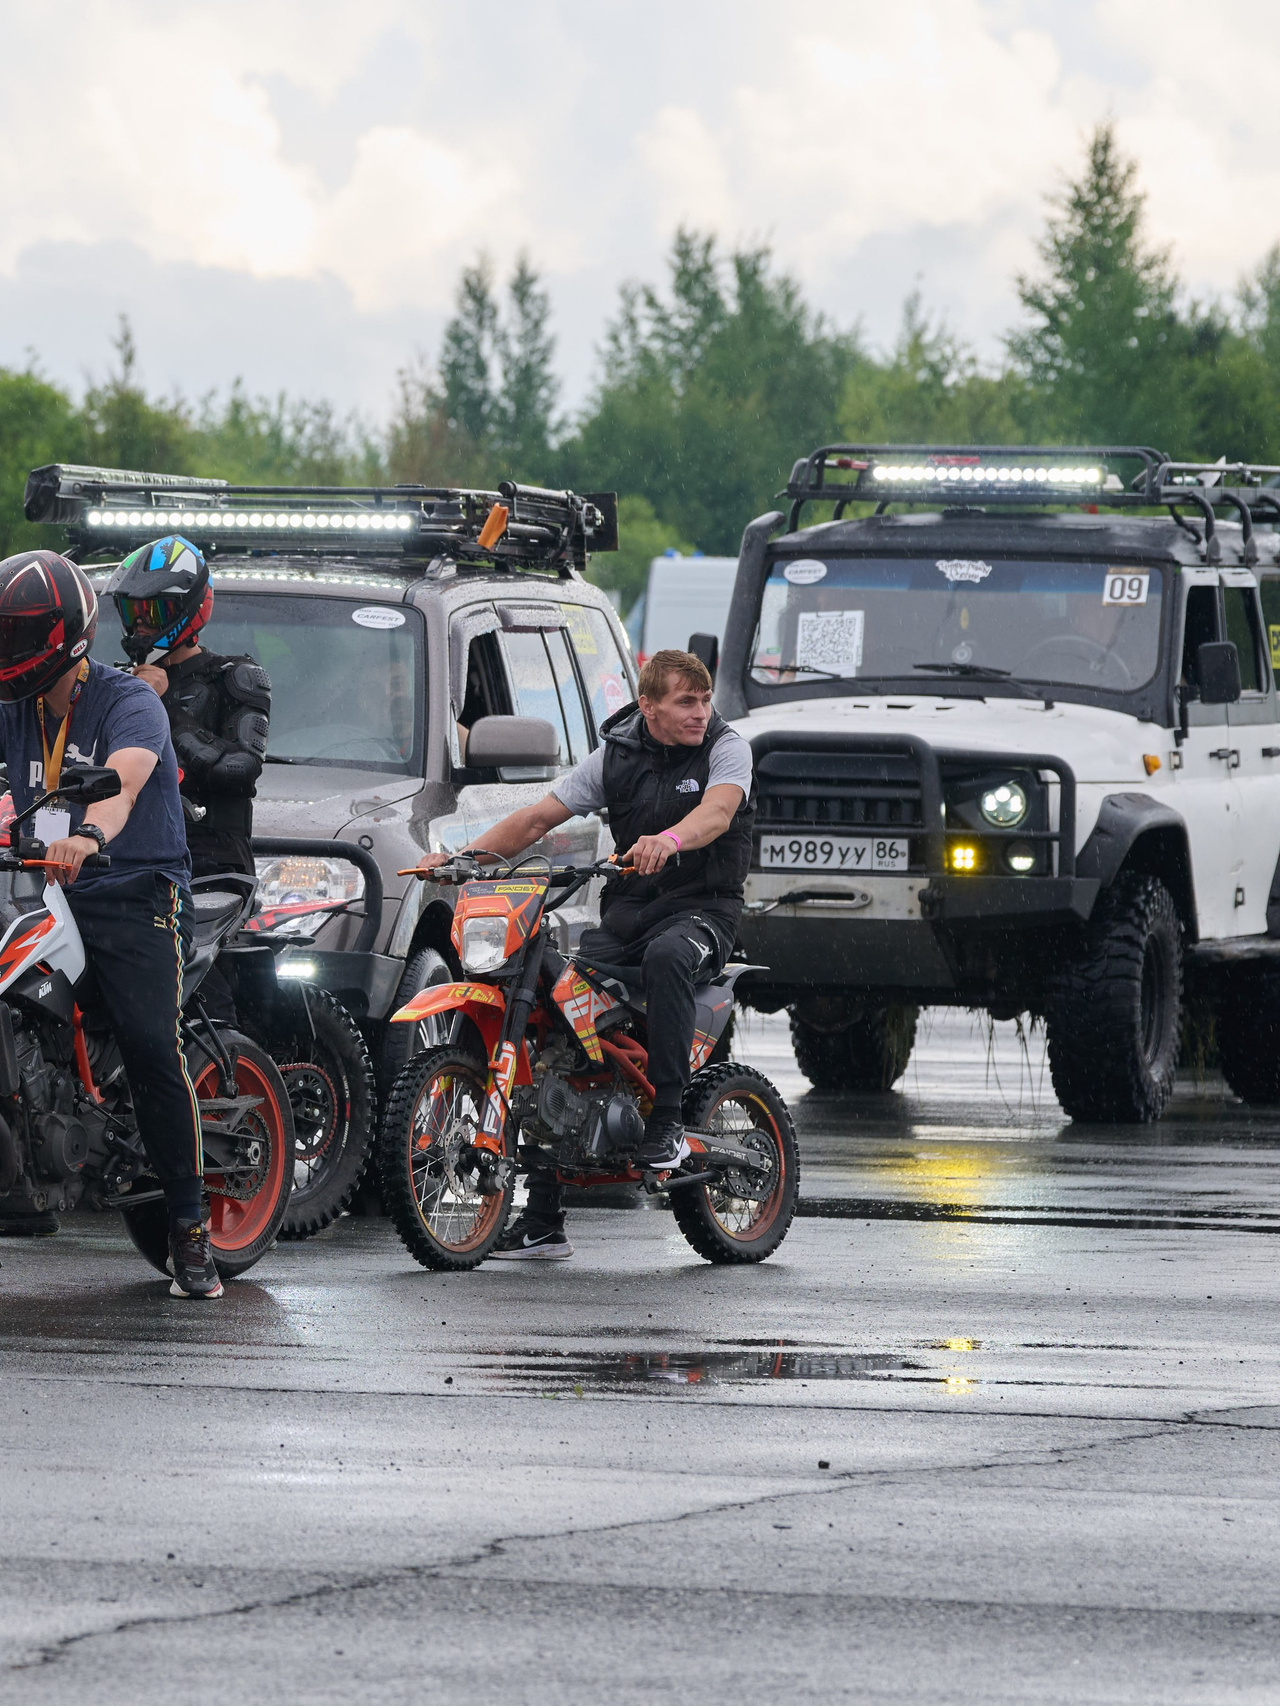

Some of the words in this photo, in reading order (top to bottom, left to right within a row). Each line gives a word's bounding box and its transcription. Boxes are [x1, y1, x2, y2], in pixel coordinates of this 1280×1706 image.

[1109, 577, 1143, 600] 09
[357, 613, 401, 622] CARFEST
[72, 642, 86, 656] BELL
[876, 841, 899, 859] 86
[38, 981, 53, 999] KTM
